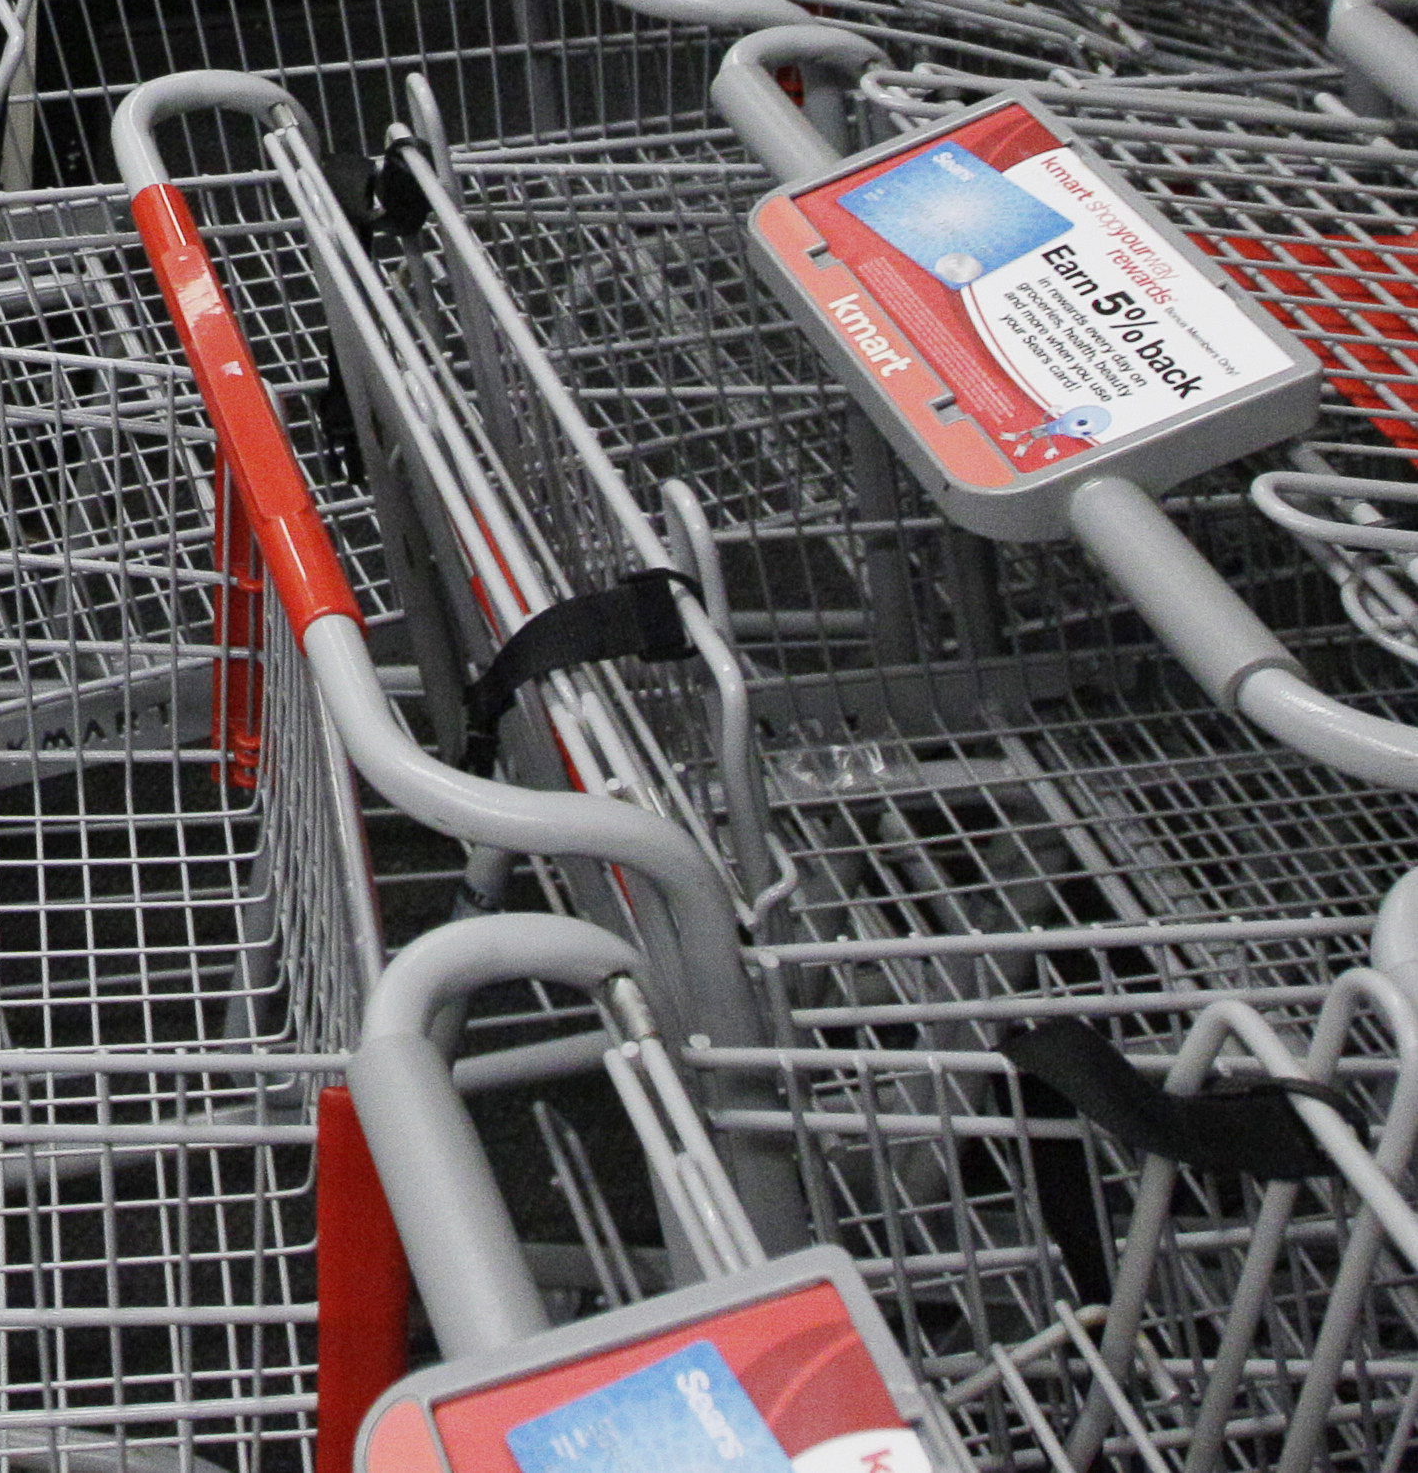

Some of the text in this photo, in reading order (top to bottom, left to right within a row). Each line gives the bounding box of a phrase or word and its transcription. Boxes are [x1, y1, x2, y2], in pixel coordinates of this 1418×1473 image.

[932, 151, 977, 183] Sears
[1042, 156, 1094, 201] kmart
[1108, 249, 1171, 304] rewards
[828, 292, 912, 377] kmart
[1001, 314, 1081, 392] your Sears card!
[1004, 292, 1112, 402] and more when you use
[1016, 282, 1131, 397] groceries, health, beauty
[1042, 244, 1201, 399] Earn 5% back
[1048, 288, 1088, 326] rewards
[1085, 326, 1115, 354] every
[1111, 353, 1134, 372] day
[1129, 372, 1148, 388] on
[676, 1369, 744, 1460] Sears
